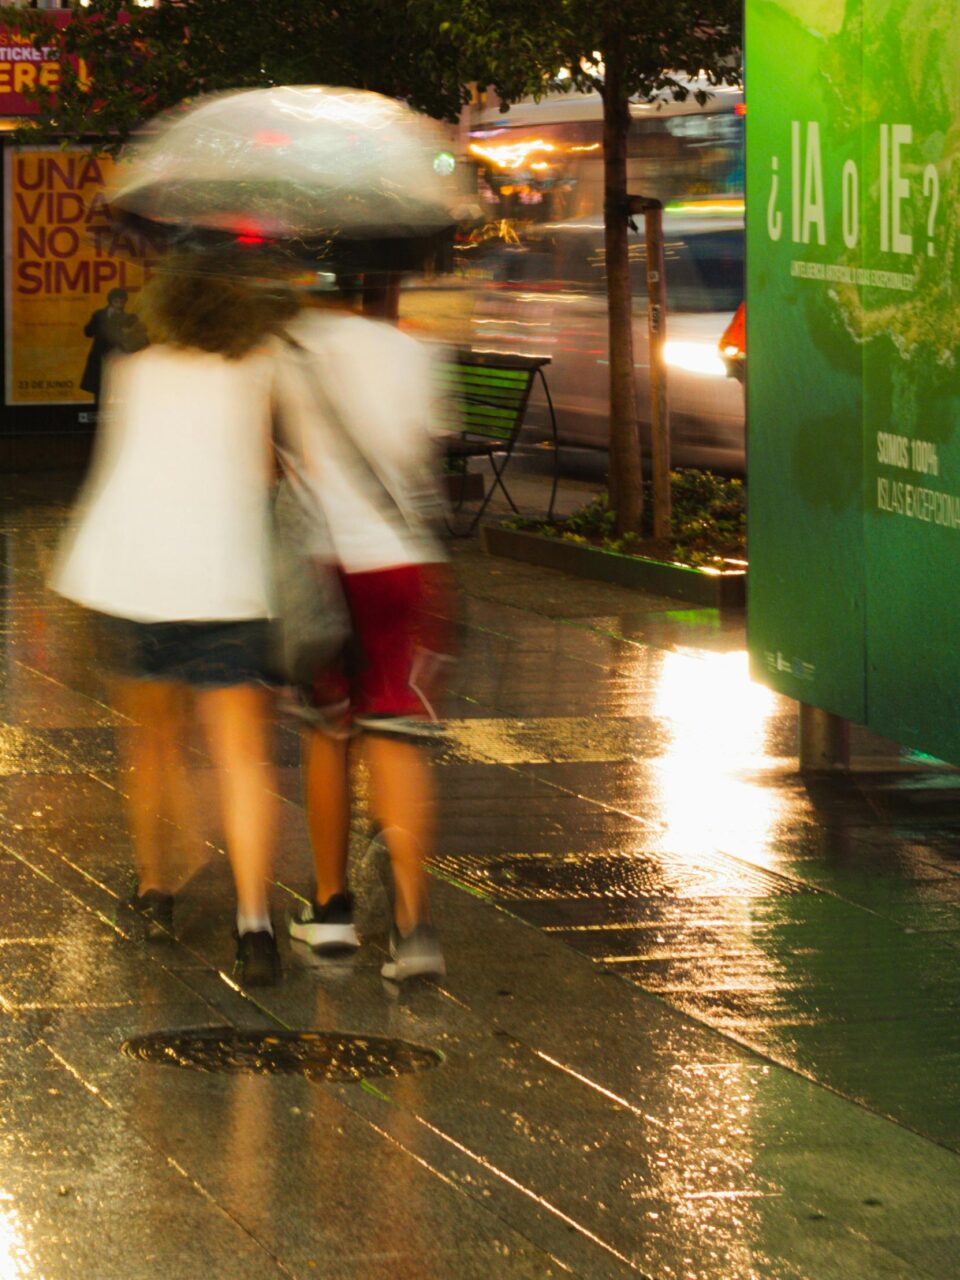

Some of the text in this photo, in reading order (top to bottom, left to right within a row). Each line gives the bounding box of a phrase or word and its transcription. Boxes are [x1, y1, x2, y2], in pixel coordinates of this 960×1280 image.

[17, 157, 105, 191] UNA
[16, 192, 113, 225] VIDA
[18, 226, 80, 259] NO
[877, 431, 939, 477] SOMOS 100%
